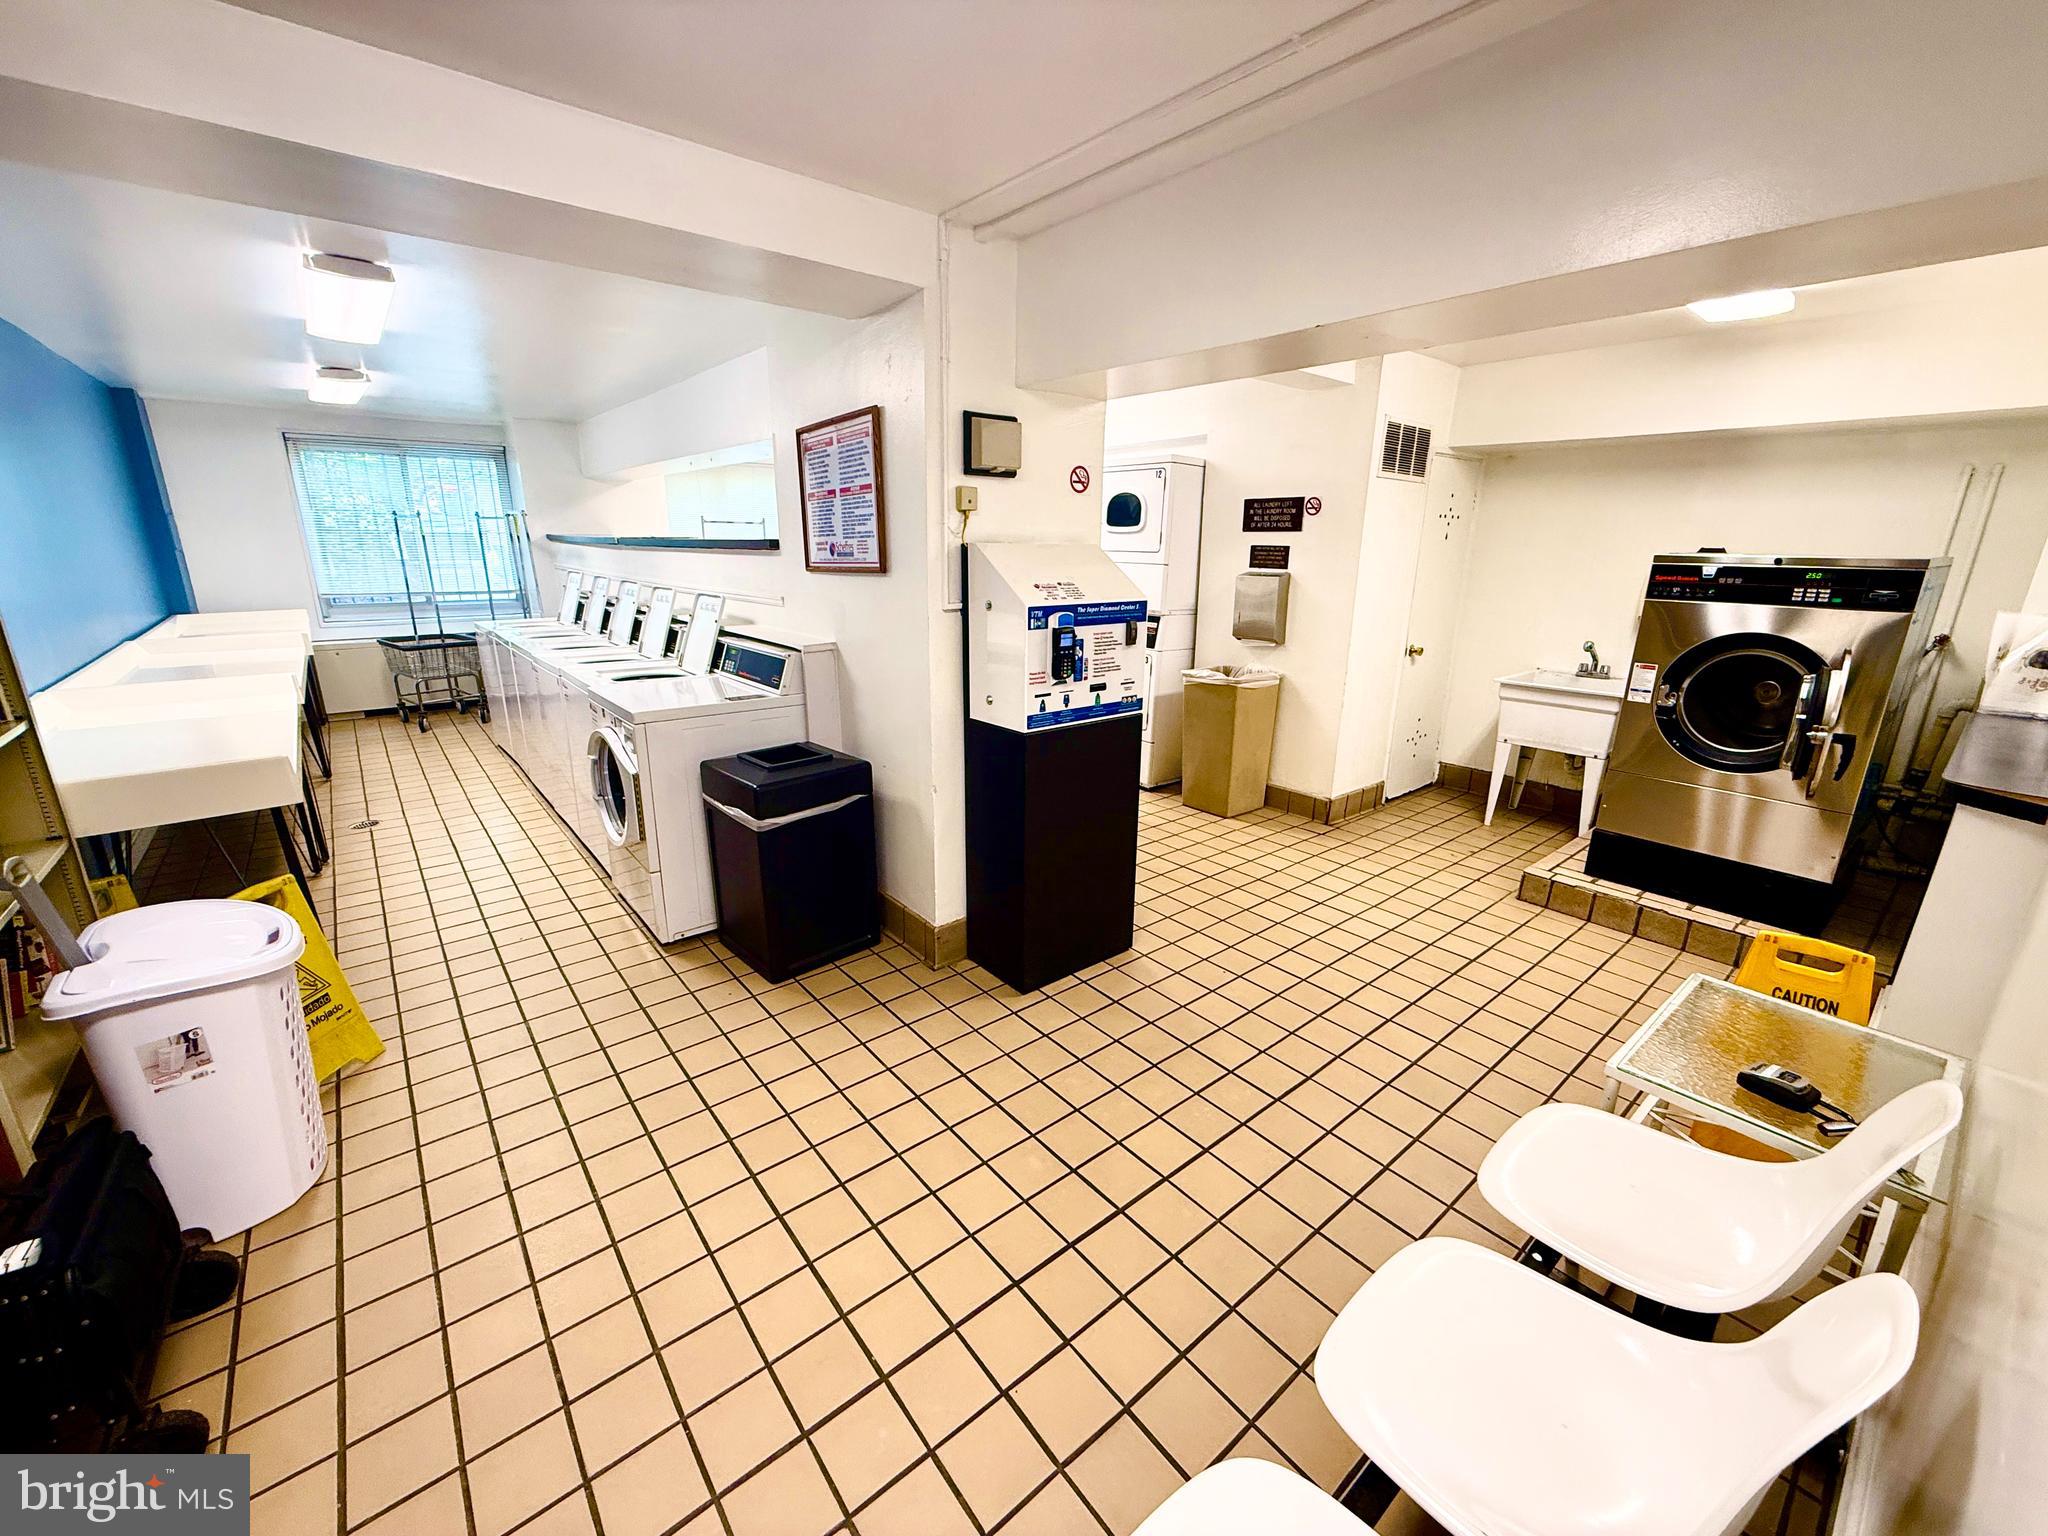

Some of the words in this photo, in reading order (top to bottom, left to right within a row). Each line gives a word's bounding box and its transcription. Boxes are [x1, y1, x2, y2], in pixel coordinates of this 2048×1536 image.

[1155, 470, 1162, 479] 12
[1086, 606, 1100, 614] Super
[1100, 604, 1120, 612] Diamond
[304, 994, 330, 1015] idado
[1771, 986, 1840, 1016] CAUTION
[310, 1003, 344, 1027] Mojado
